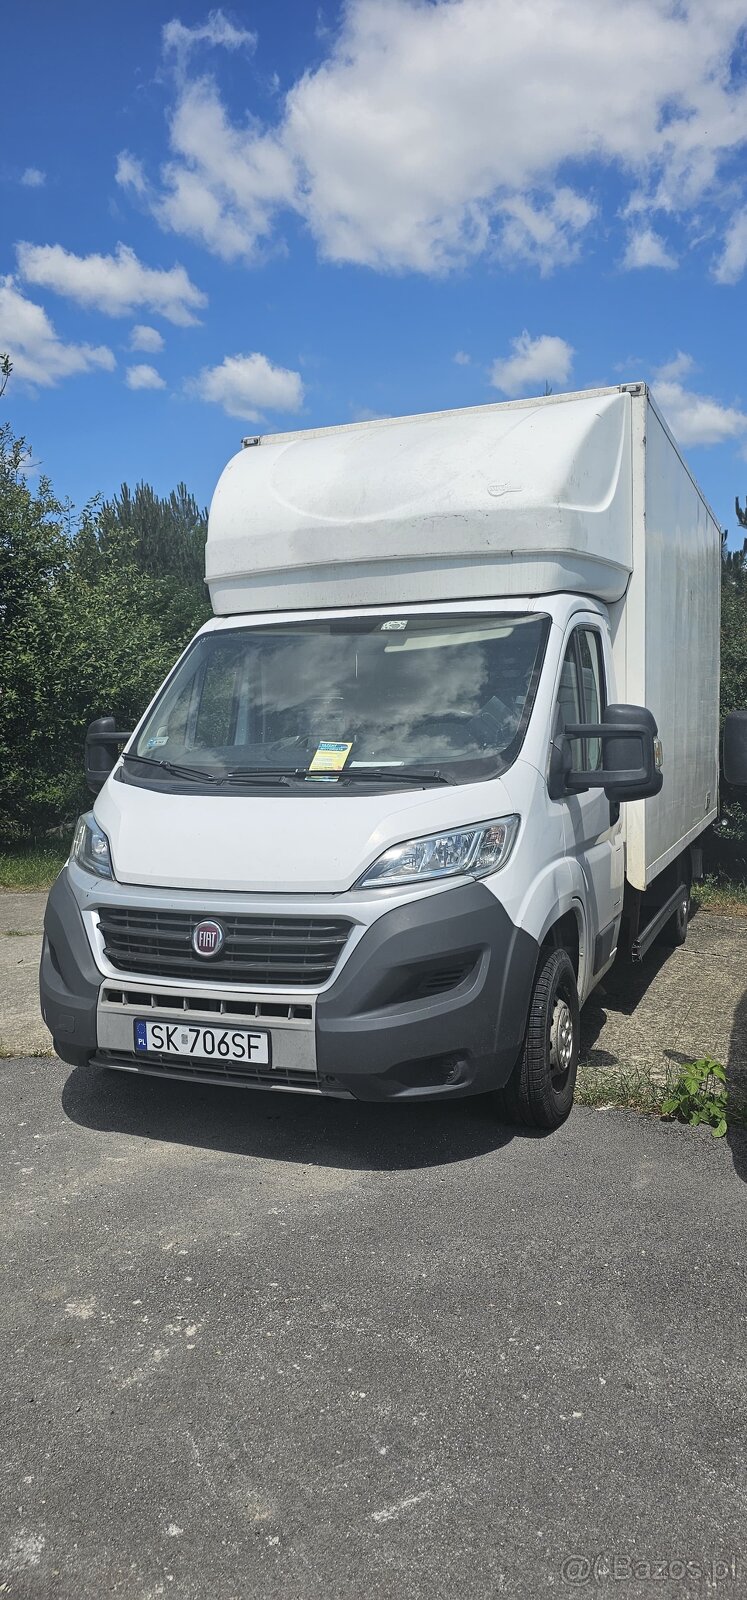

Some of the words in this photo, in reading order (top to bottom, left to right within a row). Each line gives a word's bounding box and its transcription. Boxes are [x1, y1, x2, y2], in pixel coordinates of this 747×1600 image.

[199, 931, 217, 948] FIAT
[138, 1038, 147, 1046] PL
[151, 1024, 179, 1052] SK
[188, 1028, 262, 1060] 706SF
